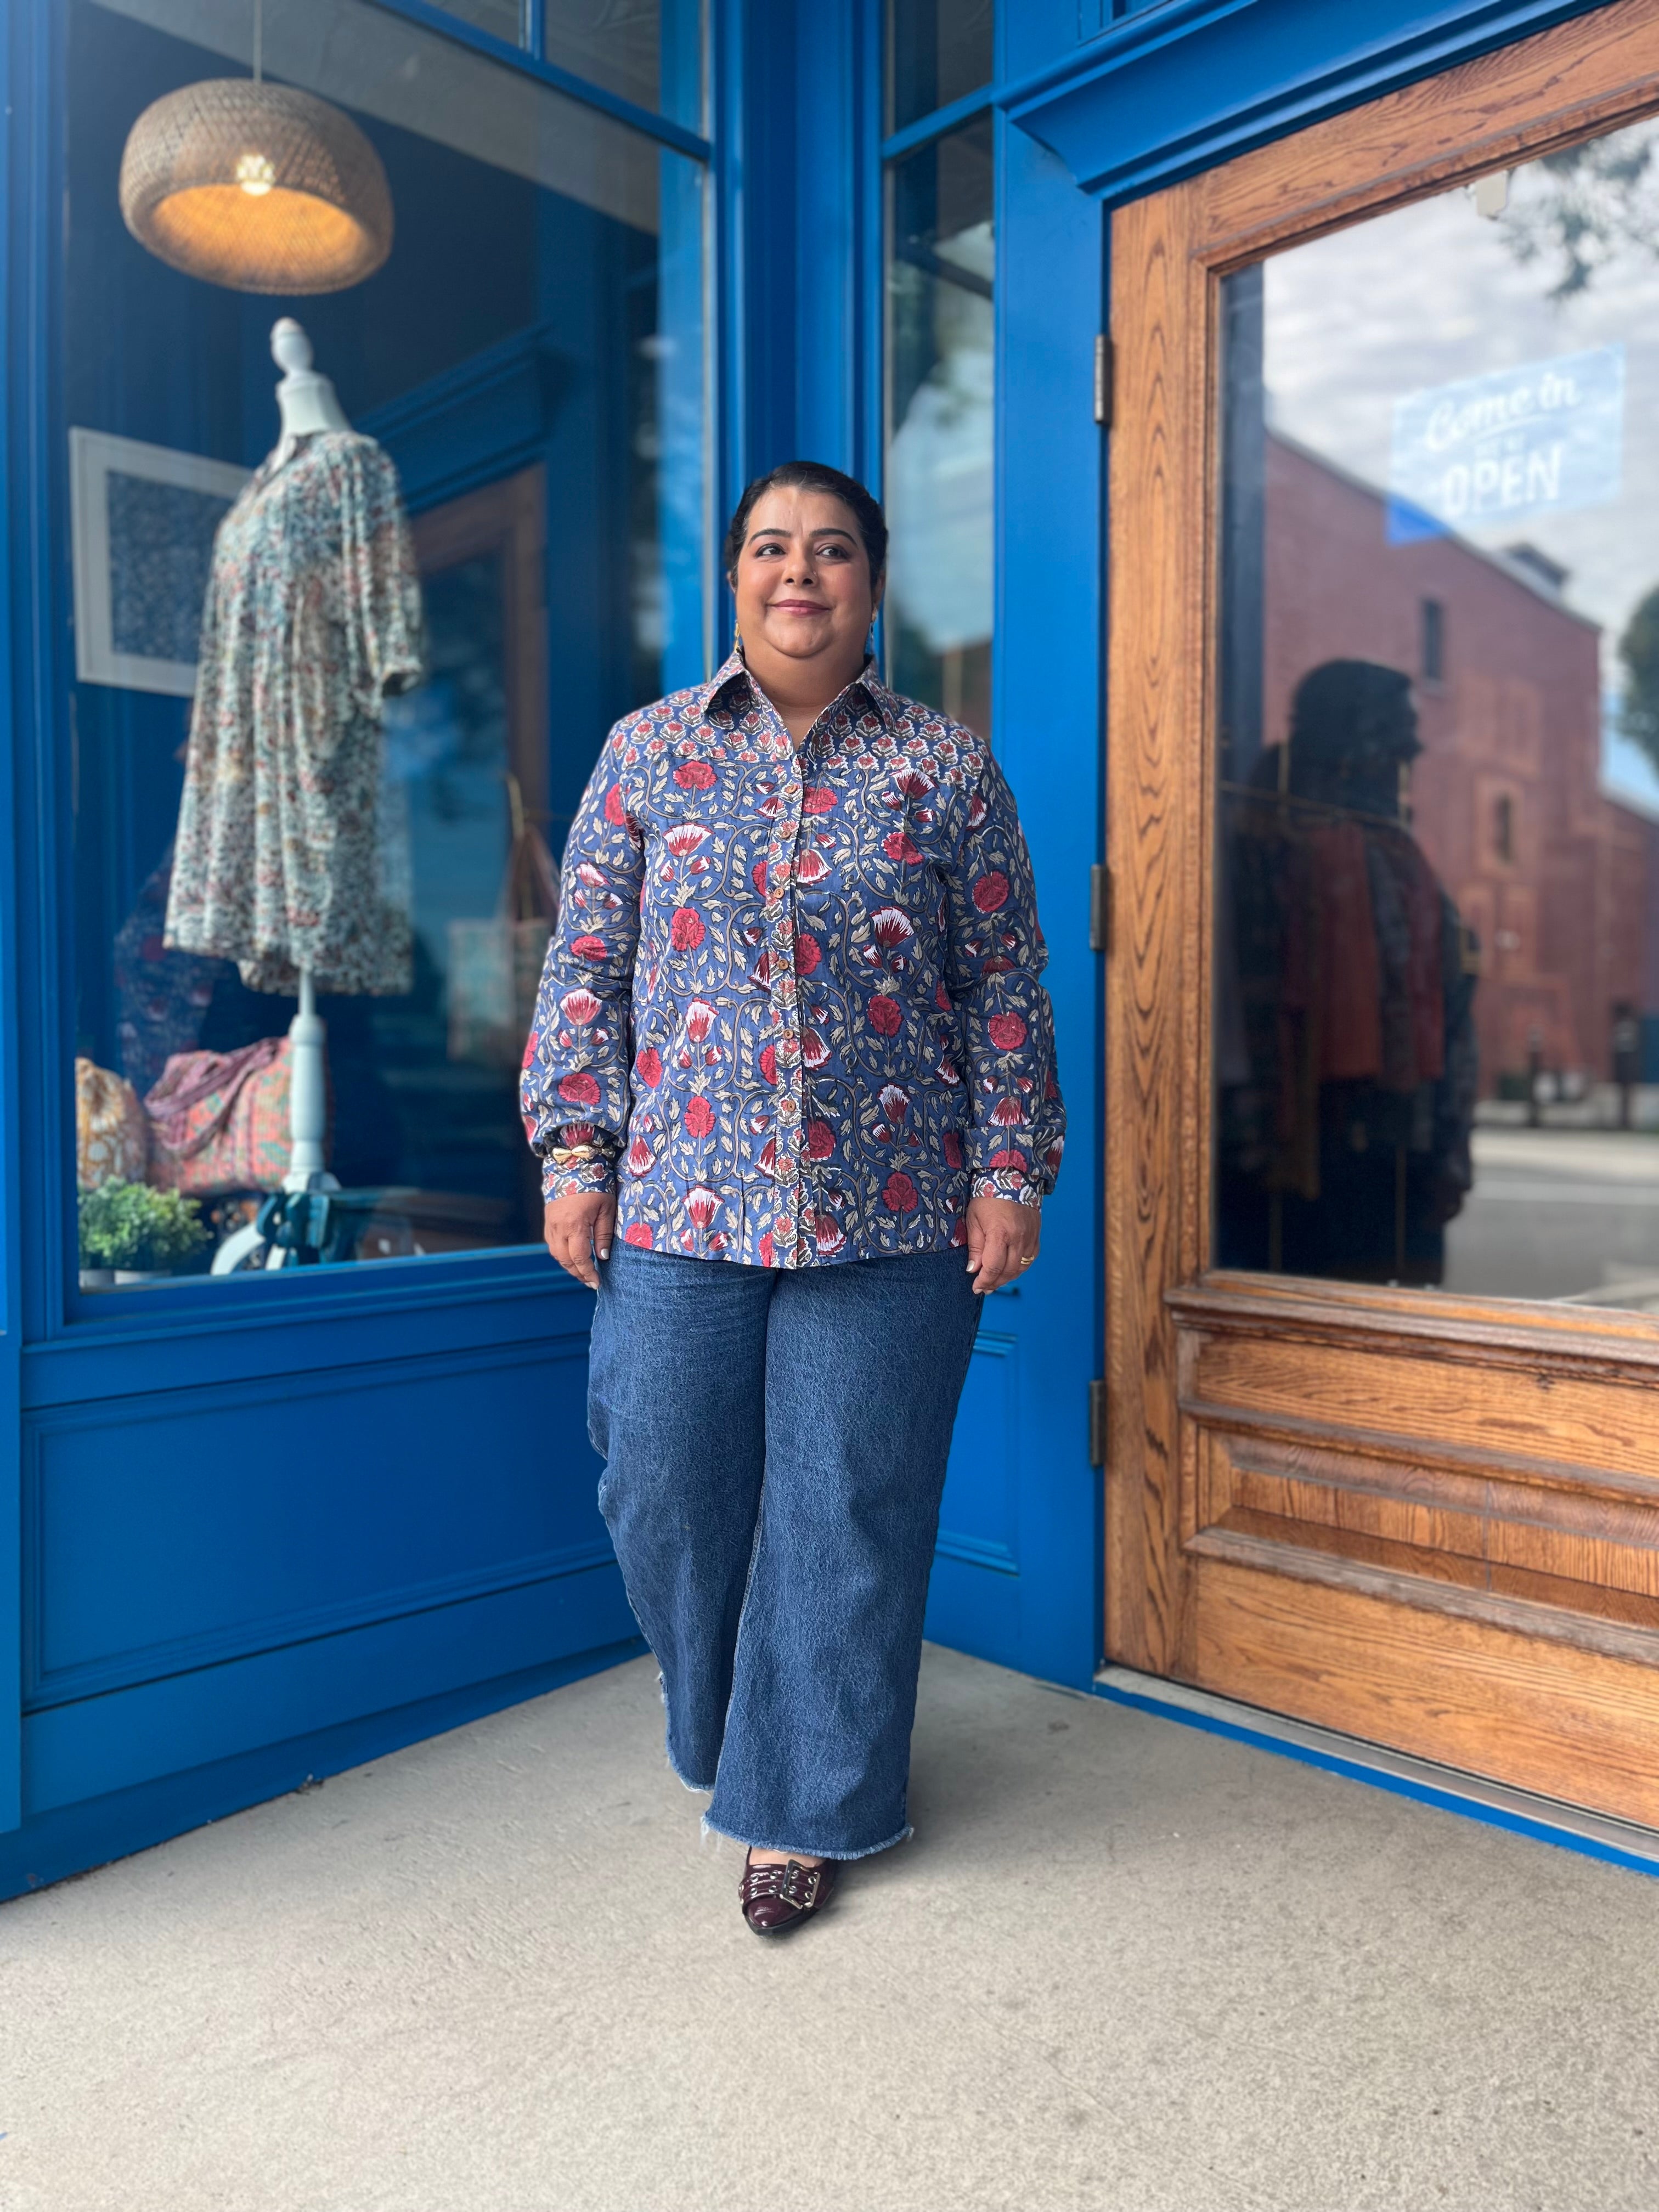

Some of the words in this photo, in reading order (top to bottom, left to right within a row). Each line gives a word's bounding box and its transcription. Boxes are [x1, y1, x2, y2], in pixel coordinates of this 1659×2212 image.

[1425, 387, 1533, 452] Come
[1538, 371, 1580, 410] in
[1441, 441, 1564, 518] OPEN
